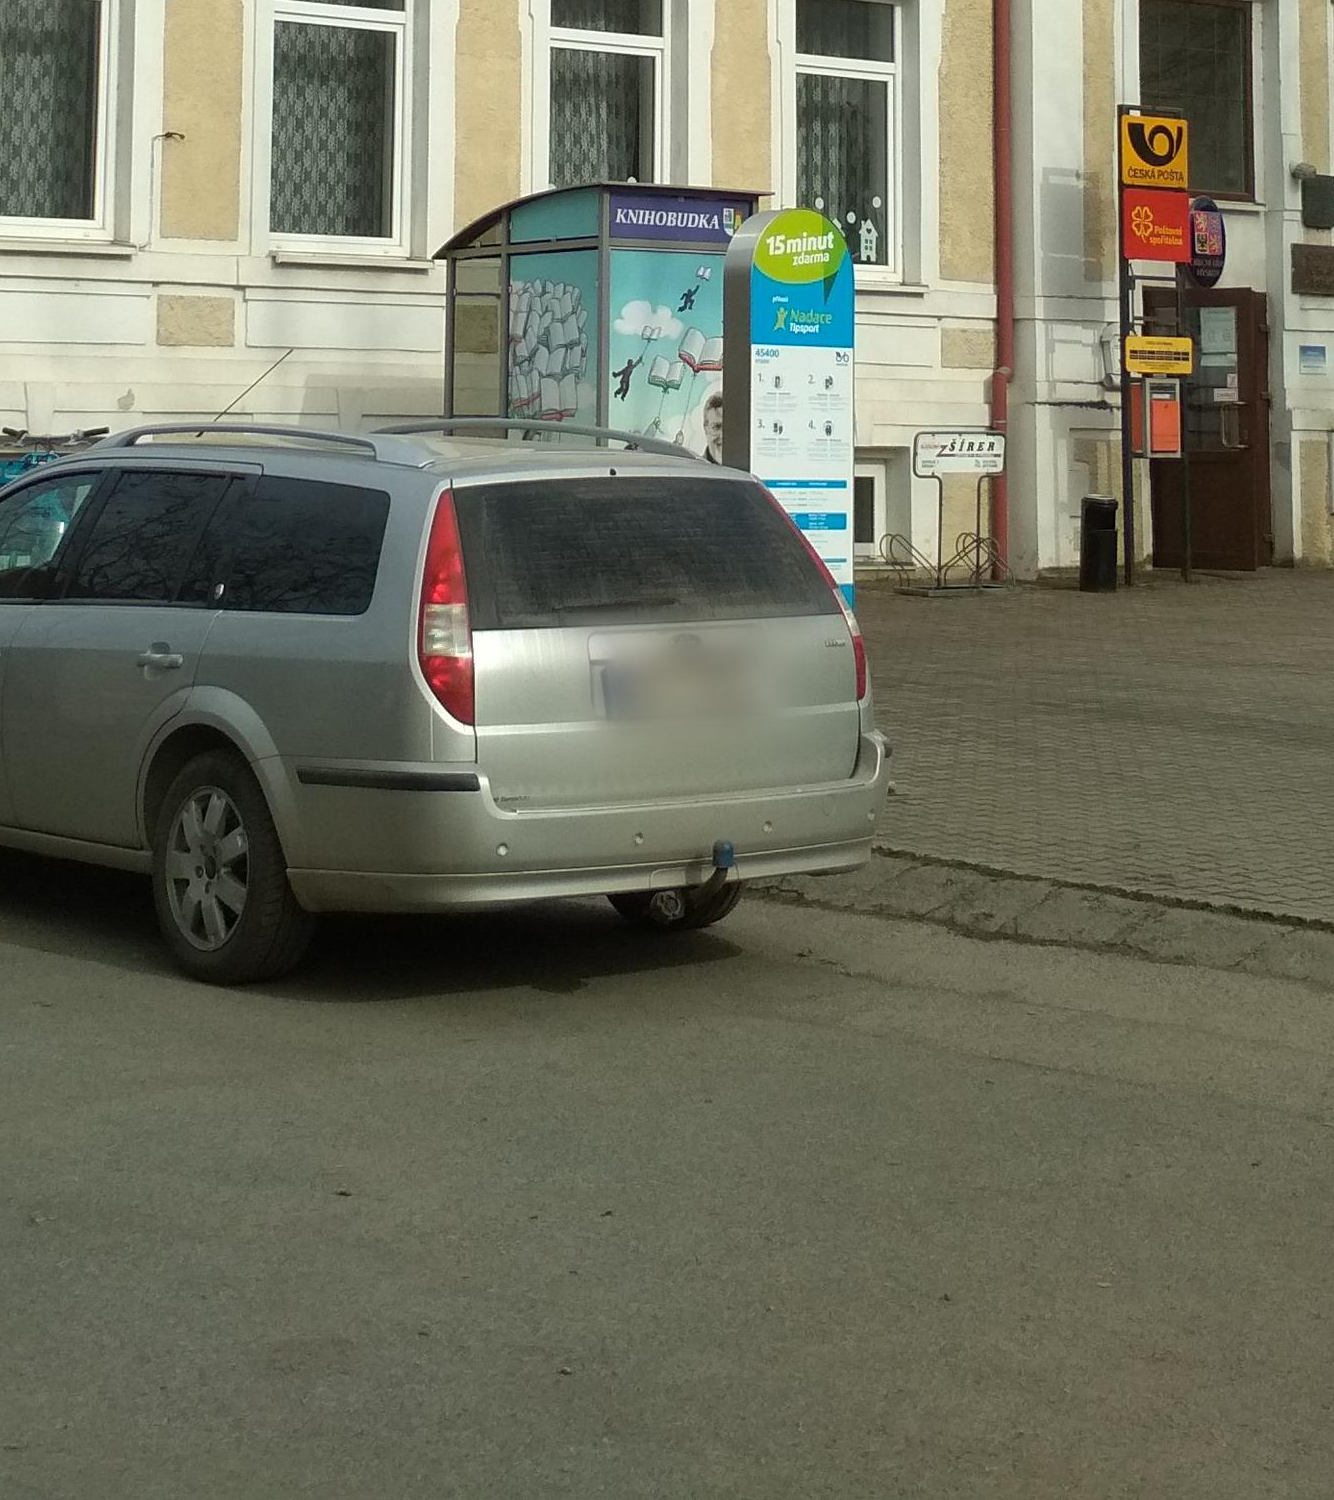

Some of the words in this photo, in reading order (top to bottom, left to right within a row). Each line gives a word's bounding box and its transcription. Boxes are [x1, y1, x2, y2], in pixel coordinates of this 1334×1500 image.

[1128, 166, 1156, 180] ČESKÁ
[1157, 168, 1184, 182] POŠTA
[615, 208, 720, 230] KNIHOBUDKA
[766, 235, 785, 256] 15
[786, 231, 834, 253] minut
[792, 252, 830, 266] zdarma
[790, 308, 833, 324] Nadace
[789, 323, 820, 334] Tipsport
[755, 349, 780, 358] 45400
[948, 438, 996, 452] ŠÍRER
